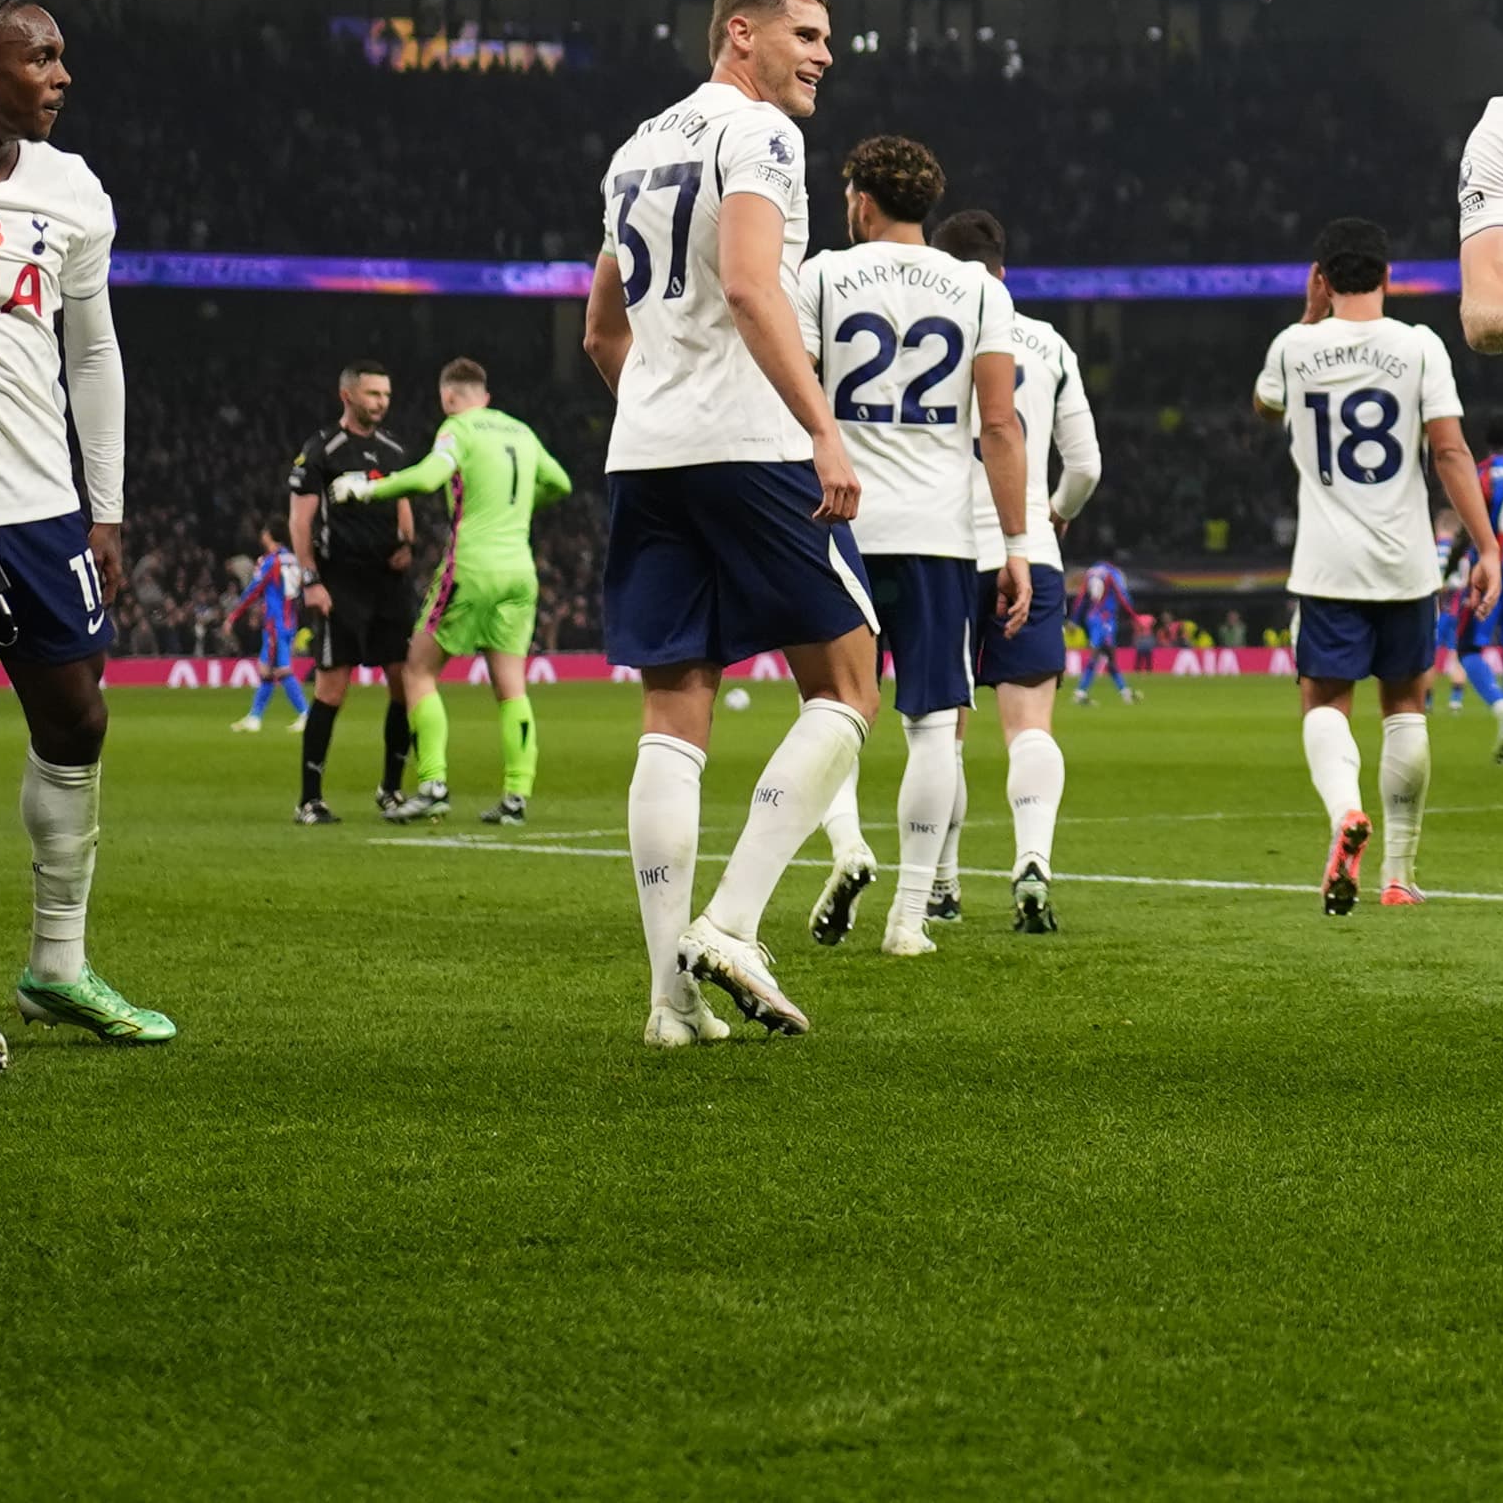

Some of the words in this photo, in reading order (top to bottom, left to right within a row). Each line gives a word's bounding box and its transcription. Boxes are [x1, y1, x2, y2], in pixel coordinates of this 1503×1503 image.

[613, 161, 704, 309] 37
[833, 264, 966, 305] MARMOUSH
[1010, 327, 1054, 361] SON
[834, 312, 964, 425] 22
[1304, 388, 1404, 487] 18
[505, 445, 518, 506] 1
[68, 548, 103, 613] 11
[167, 659, 261, 689] AIA
[1171, 647, 1241, 676] AIA
[754, 787, 784, 808] THFC
[908, 821, 938, 836] THFC
[639, 865, 670, 888] THFC
